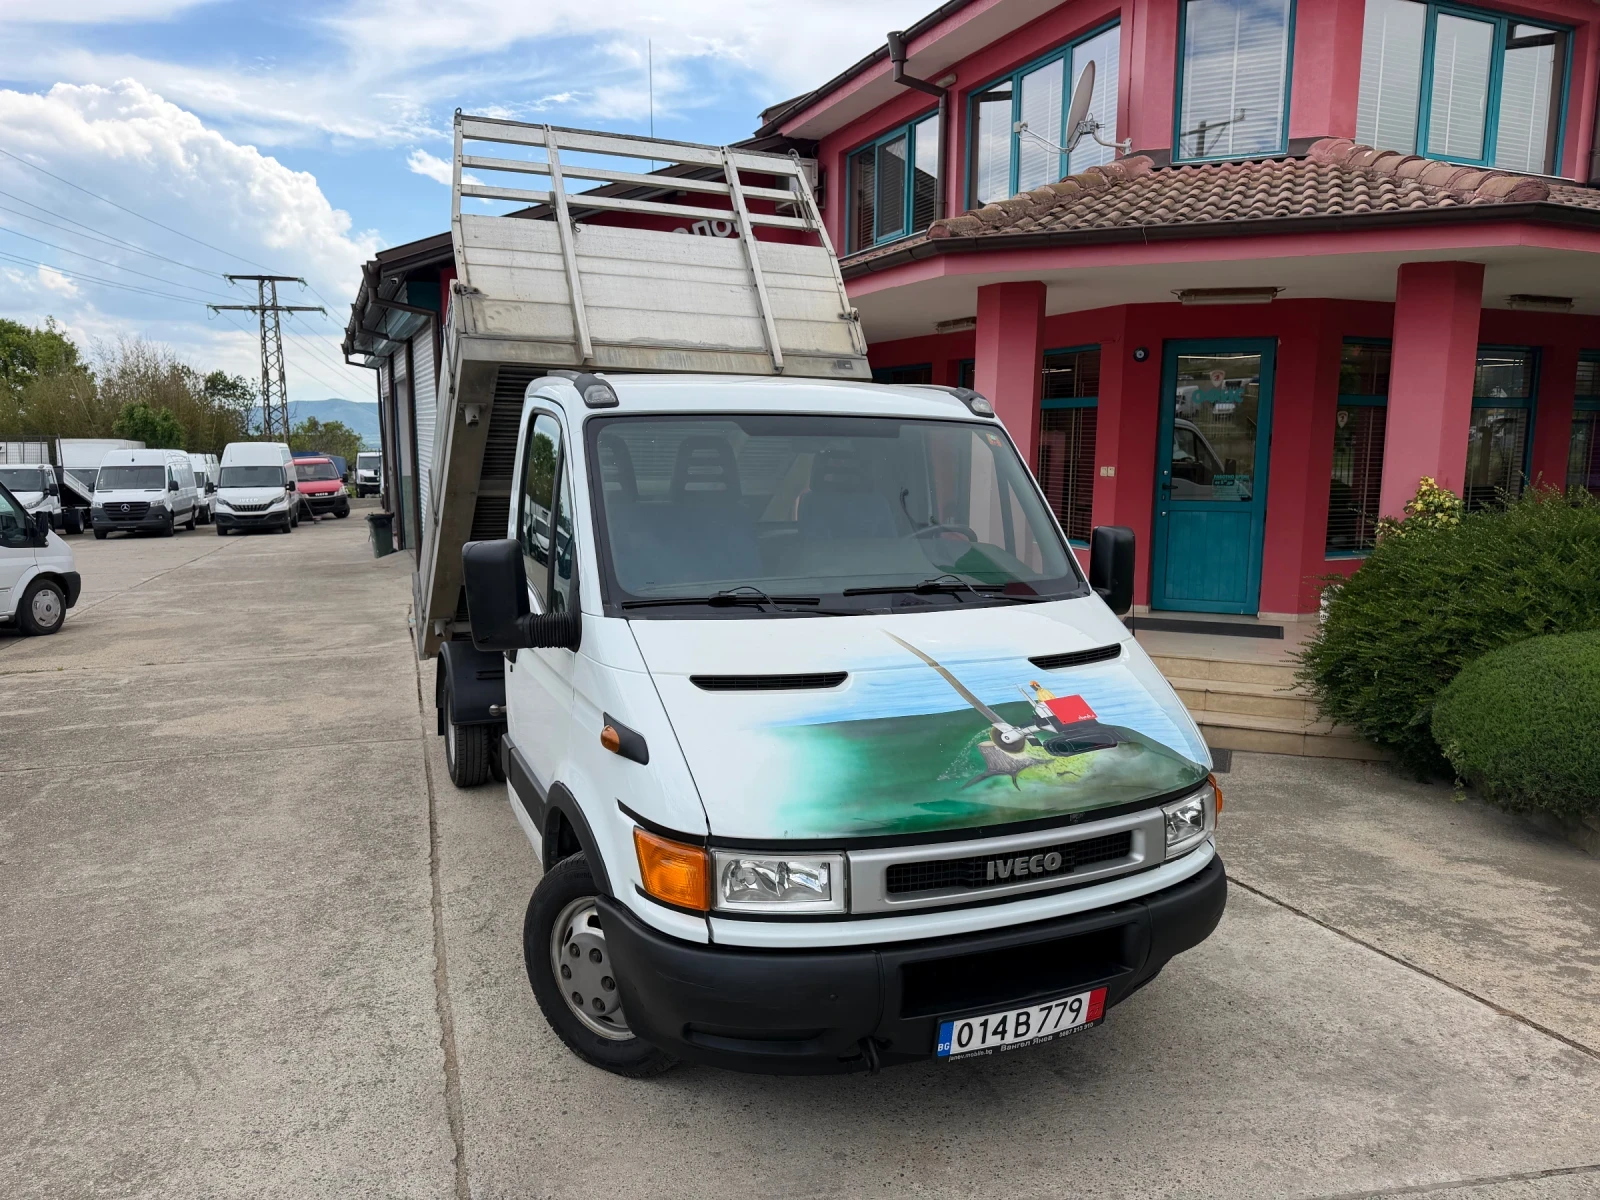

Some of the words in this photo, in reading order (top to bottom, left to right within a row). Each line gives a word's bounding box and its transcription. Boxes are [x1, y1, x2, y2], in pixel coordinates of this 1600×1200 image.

[986, 851, 1062, 881] IVECO
[937, 1042, 950, 1052] BG
[956, 997, 1083, 1049] 014B779
